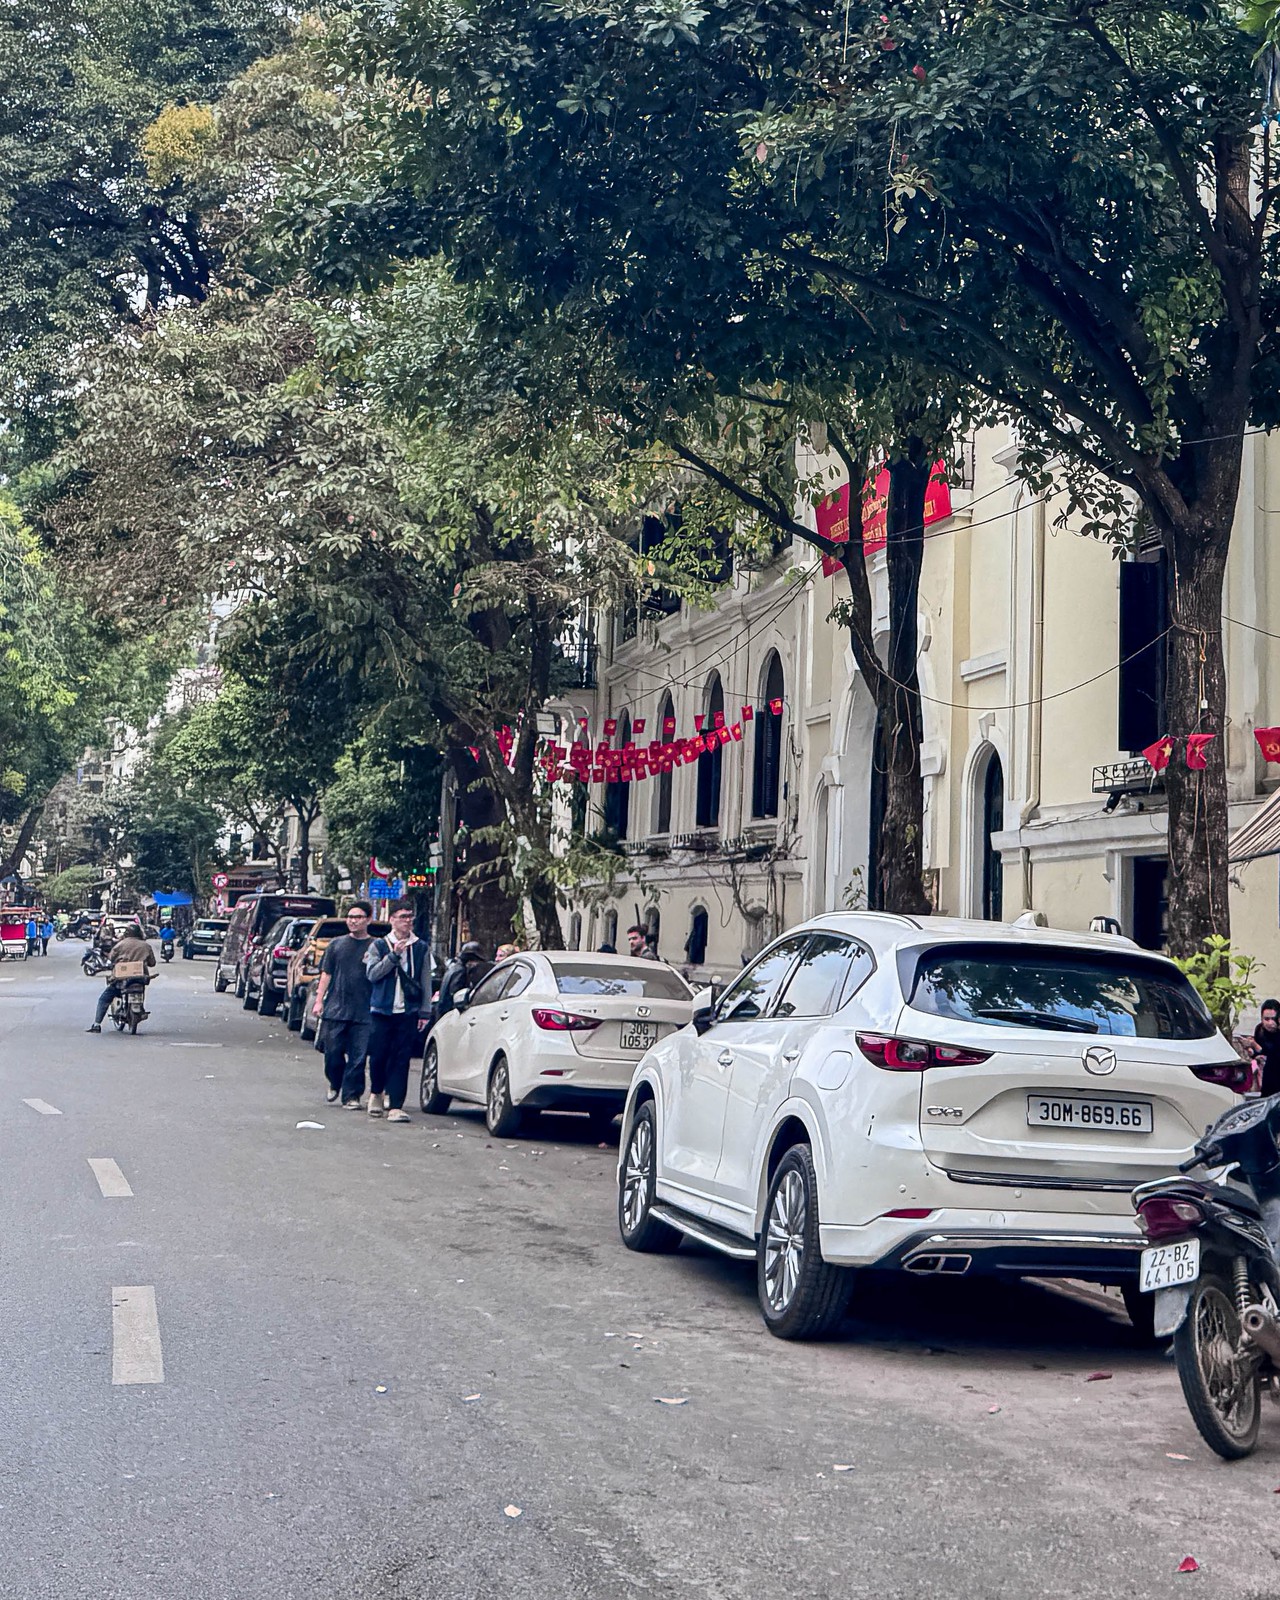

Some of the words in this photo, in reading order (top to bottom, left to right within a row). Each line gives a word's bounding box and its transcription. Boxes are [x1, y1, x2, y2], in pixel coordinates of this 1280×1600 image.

[629, 1022, 649, 1036] 30G
[1039, 1102, 1142, 1127] 30M-869.66
[1150, 1244, 1189, 1268] 22-B2
[1145, 1261, 1195, 1288] 441.05
